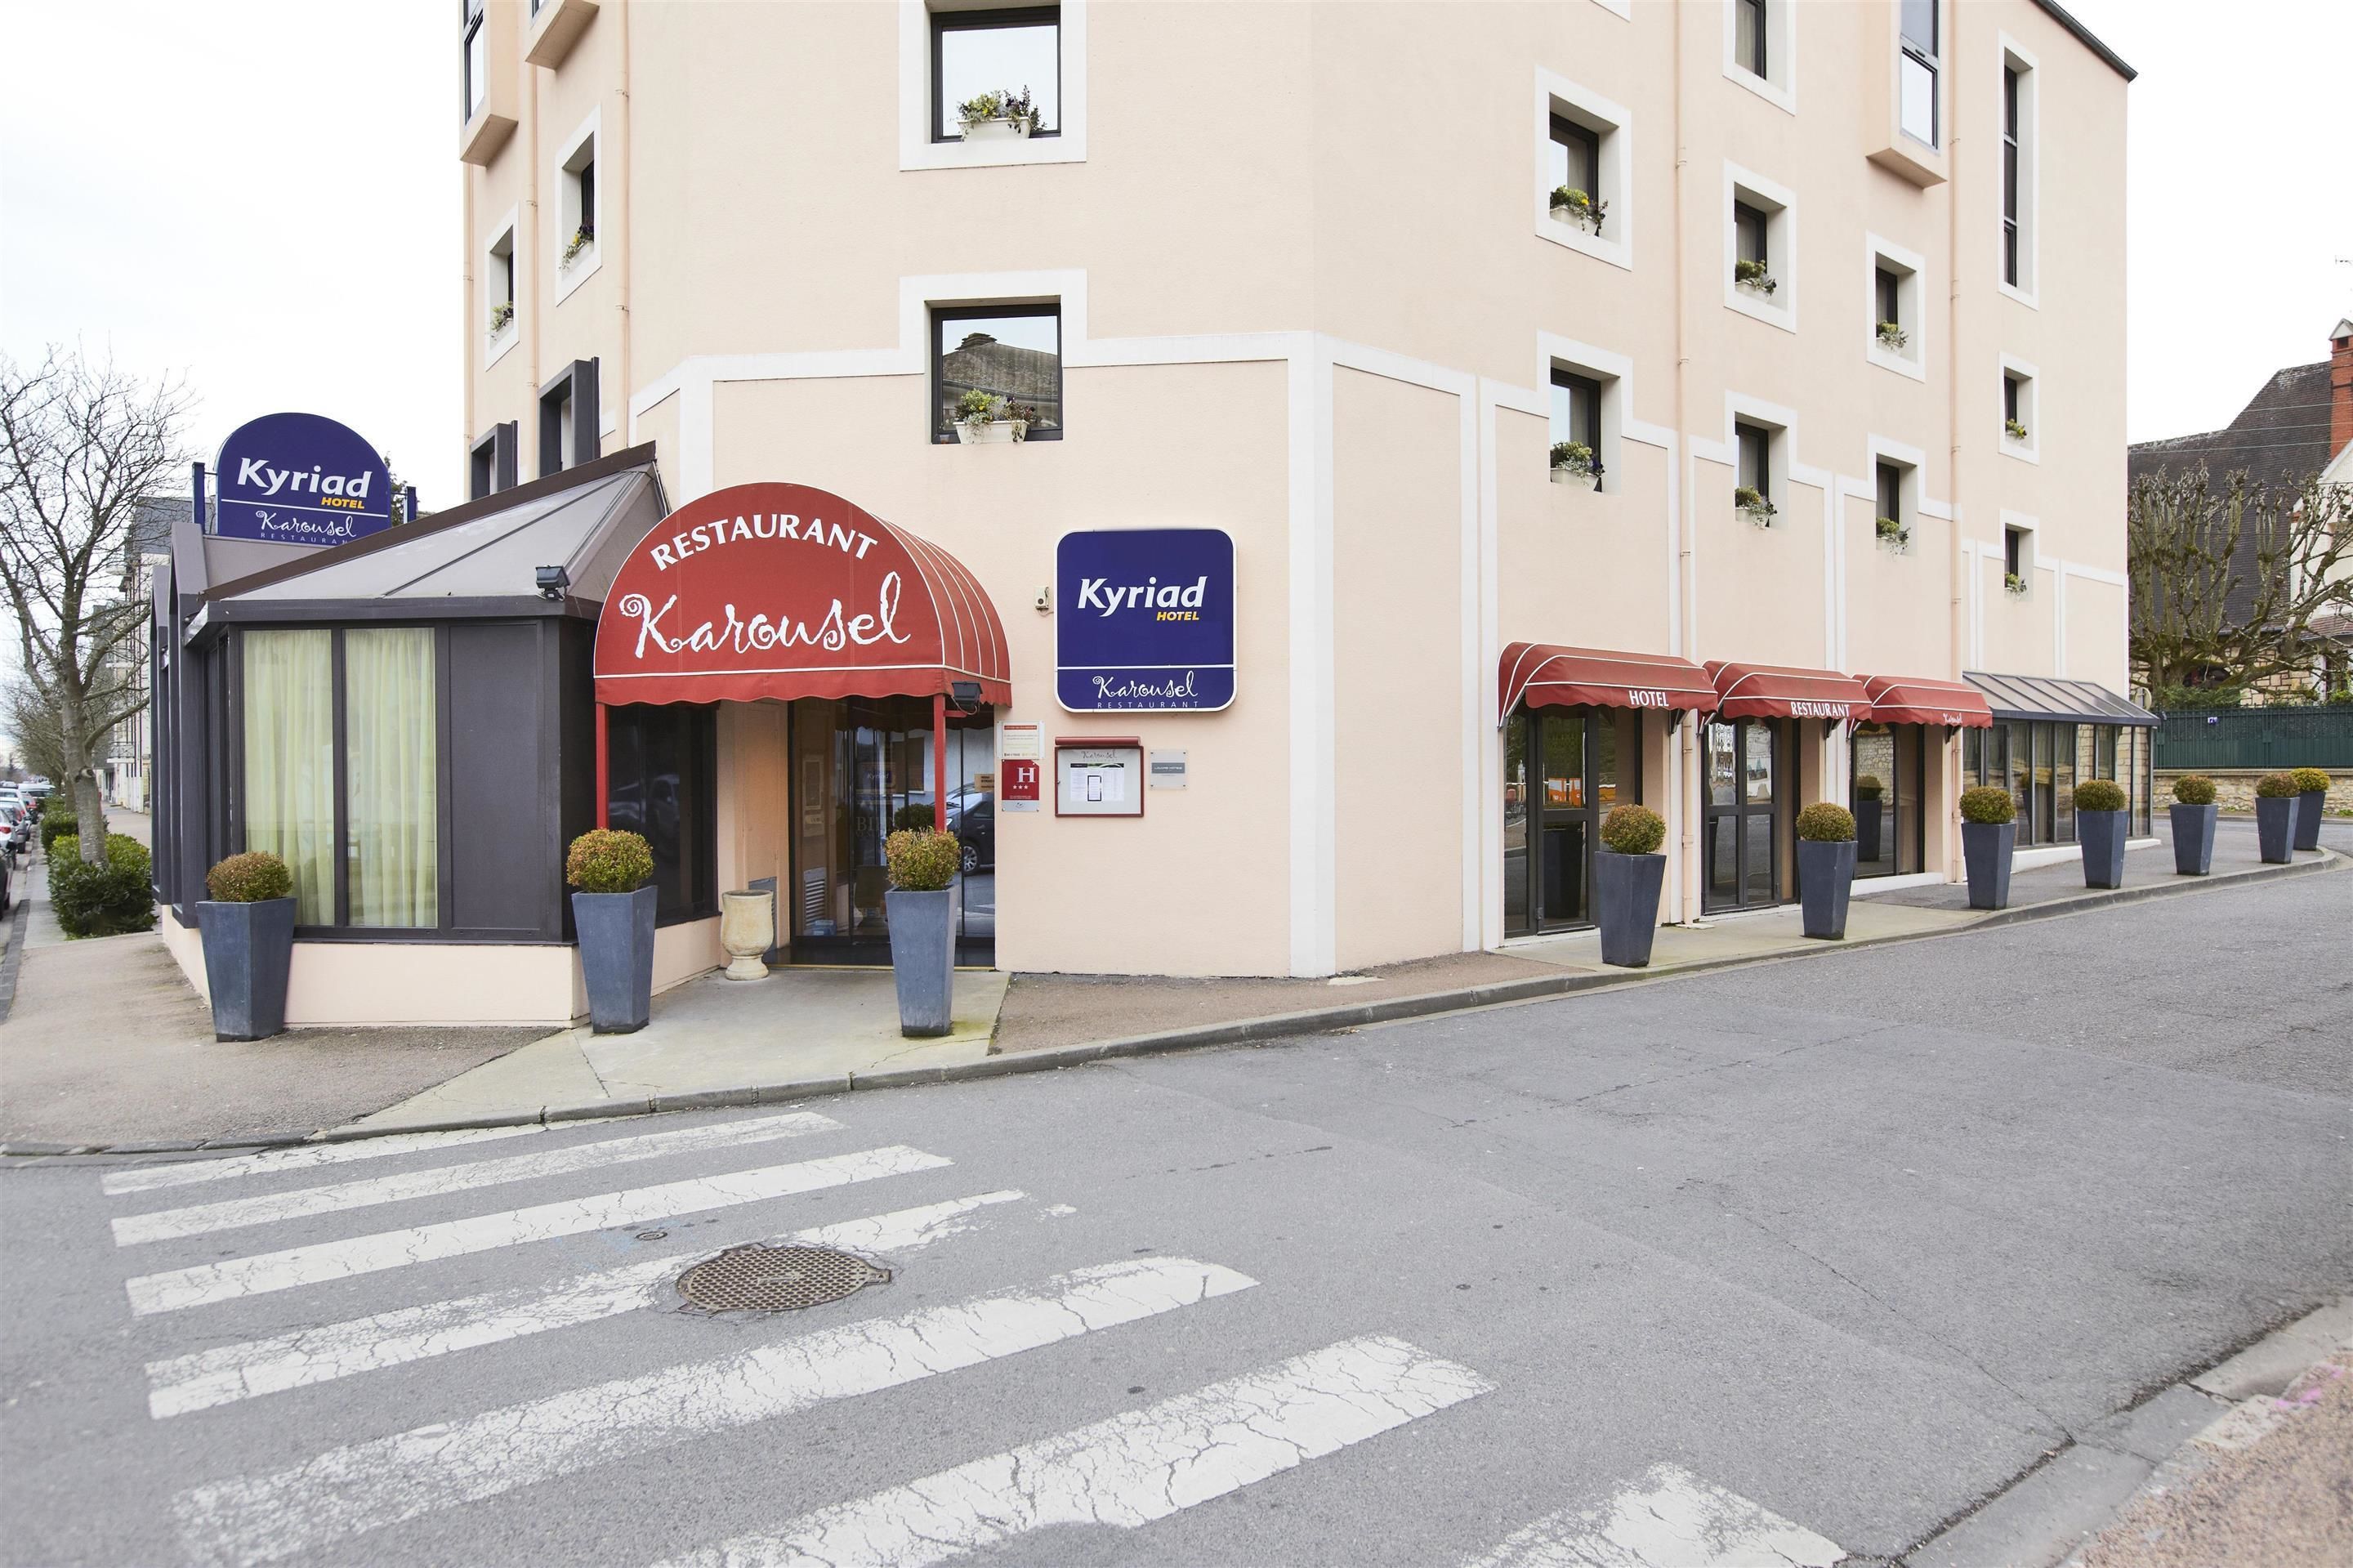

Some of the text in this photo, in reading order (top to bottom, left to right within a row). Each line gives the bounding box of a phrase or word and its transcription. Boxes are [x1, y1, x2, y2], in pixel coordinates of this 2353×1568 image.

[237, 458, 373, 498] Kyriad
[321, 497, 364, 509] HOTEL
[256, 510, 356, 537] Karousel
[261, 533, 348, 544] RESTAURAN
[650, 513, 877, 571] RESTAURANT
[1078, 576, 1208, 617] Kyriad
[619, 570, 911, 659] Karousel
[1157, 611, 1199, 621] HOTEL
[1092, 670, 1198, 699] Karousel
[1628, 690, 1669, 708] HOTEL
[1791, 701, 1851, 717] RESTAURANT
[1017, 767, 1036, 783] H
